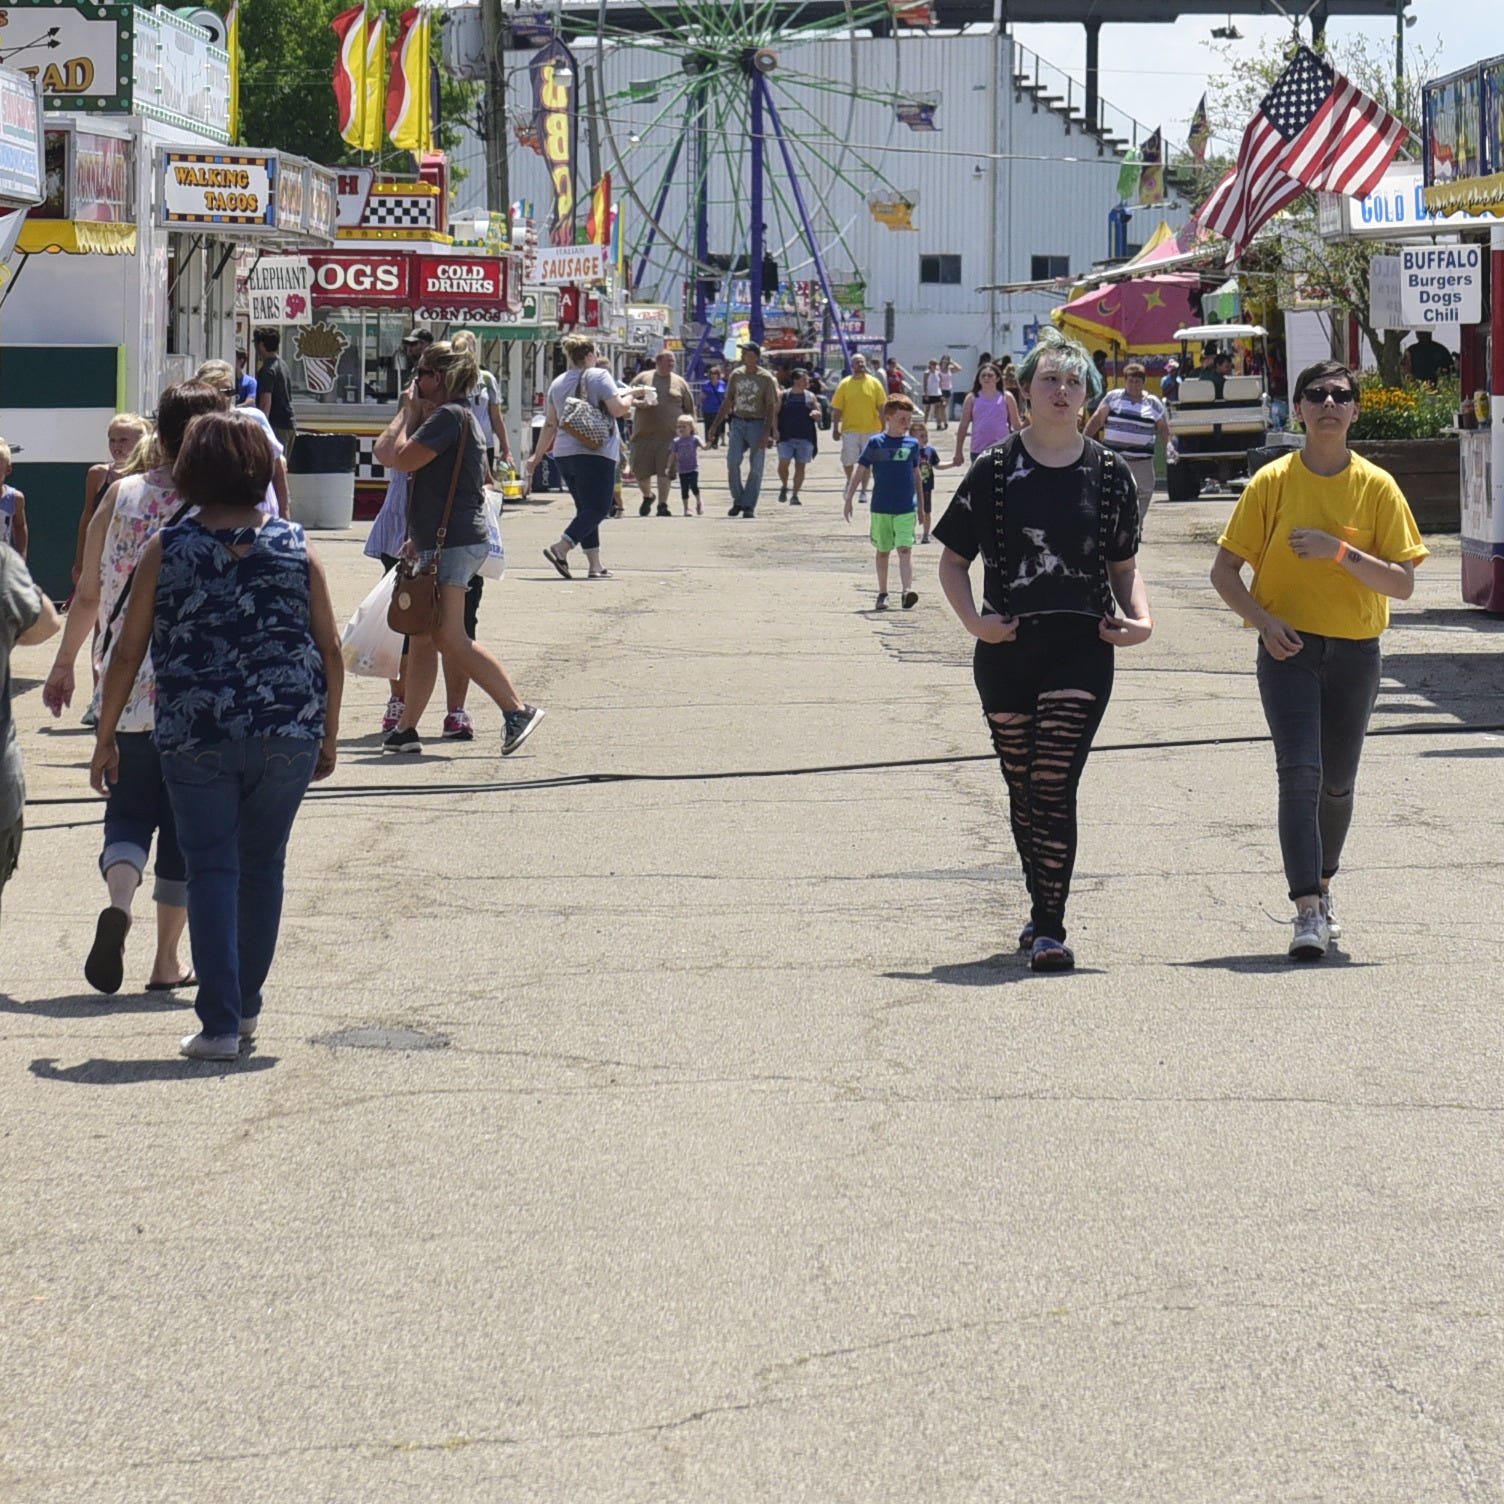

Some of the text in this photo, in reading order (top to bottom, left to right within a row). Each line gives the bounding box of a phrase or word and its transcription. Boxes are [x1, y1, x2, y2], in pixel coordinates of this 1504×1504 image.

[174, 167, 249, 188] WALKING
[204, 191, 258, 212] TACOS
[556, 247, 586, 257] ITALIAN
[1403, 249, 1479, 270] BUFFALO
[436, 265, 485, 280] COLD
[541, 256, 599, 280] SAUSAGE
[249, 266, 308, 292] ELEPHANT
[426, 278, 495, 294] DRINKS
[1408, 274, 1473, 289] Burgers
[1419, 291, 1462, 306] Dogs
[252, 295, 280, 321] EARS
[420, 308, 460, 322] CORN
[462, 308, 500, 322] DOGS
[1424, 307, 1459, 322] Chili
